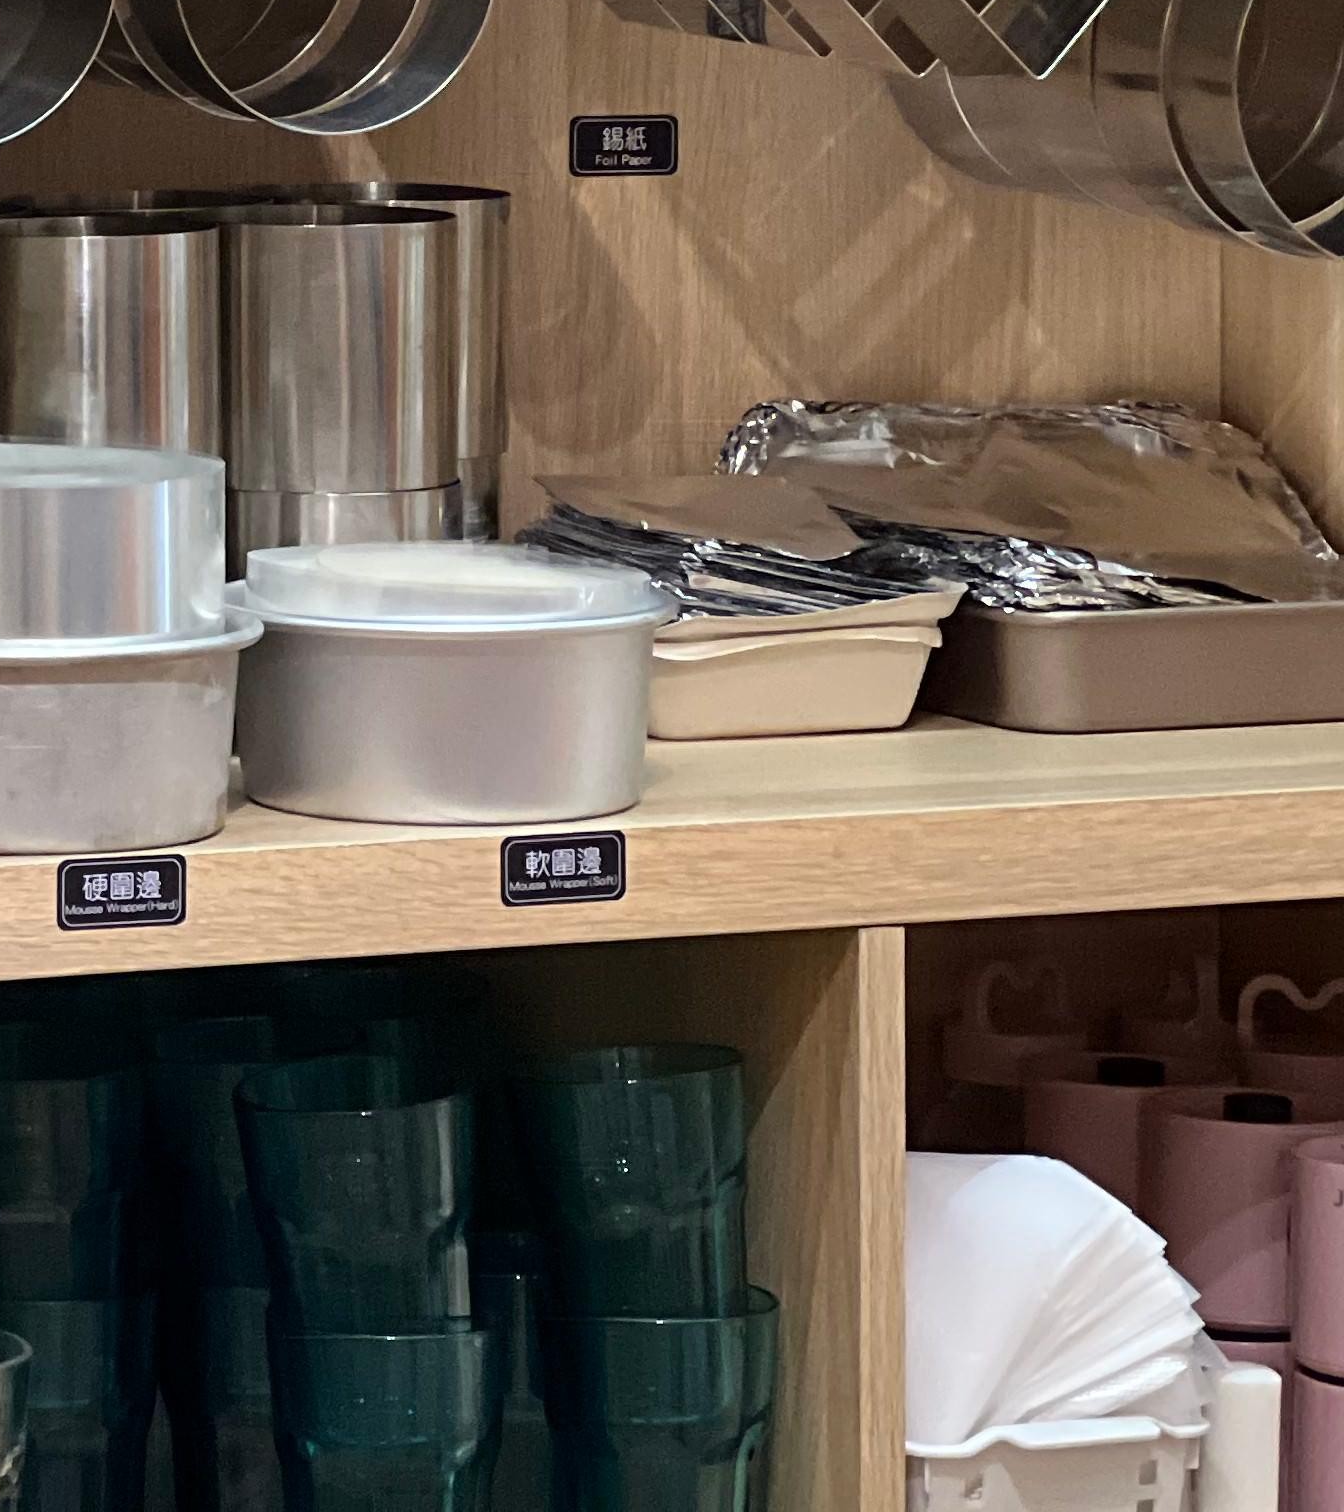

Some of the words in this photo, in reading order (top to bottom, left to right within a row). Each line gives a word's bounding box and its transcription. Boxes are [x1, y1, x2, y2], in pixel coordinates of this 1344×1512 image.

[602, 127, 647, 151] 錫紙
[595, 154, 618, 165] Foil
[621, 154, 652, 165] Paper
[525, 847, 602, 878] 軟圍邊
[82, 871, 162, 901] 硬圍邊
